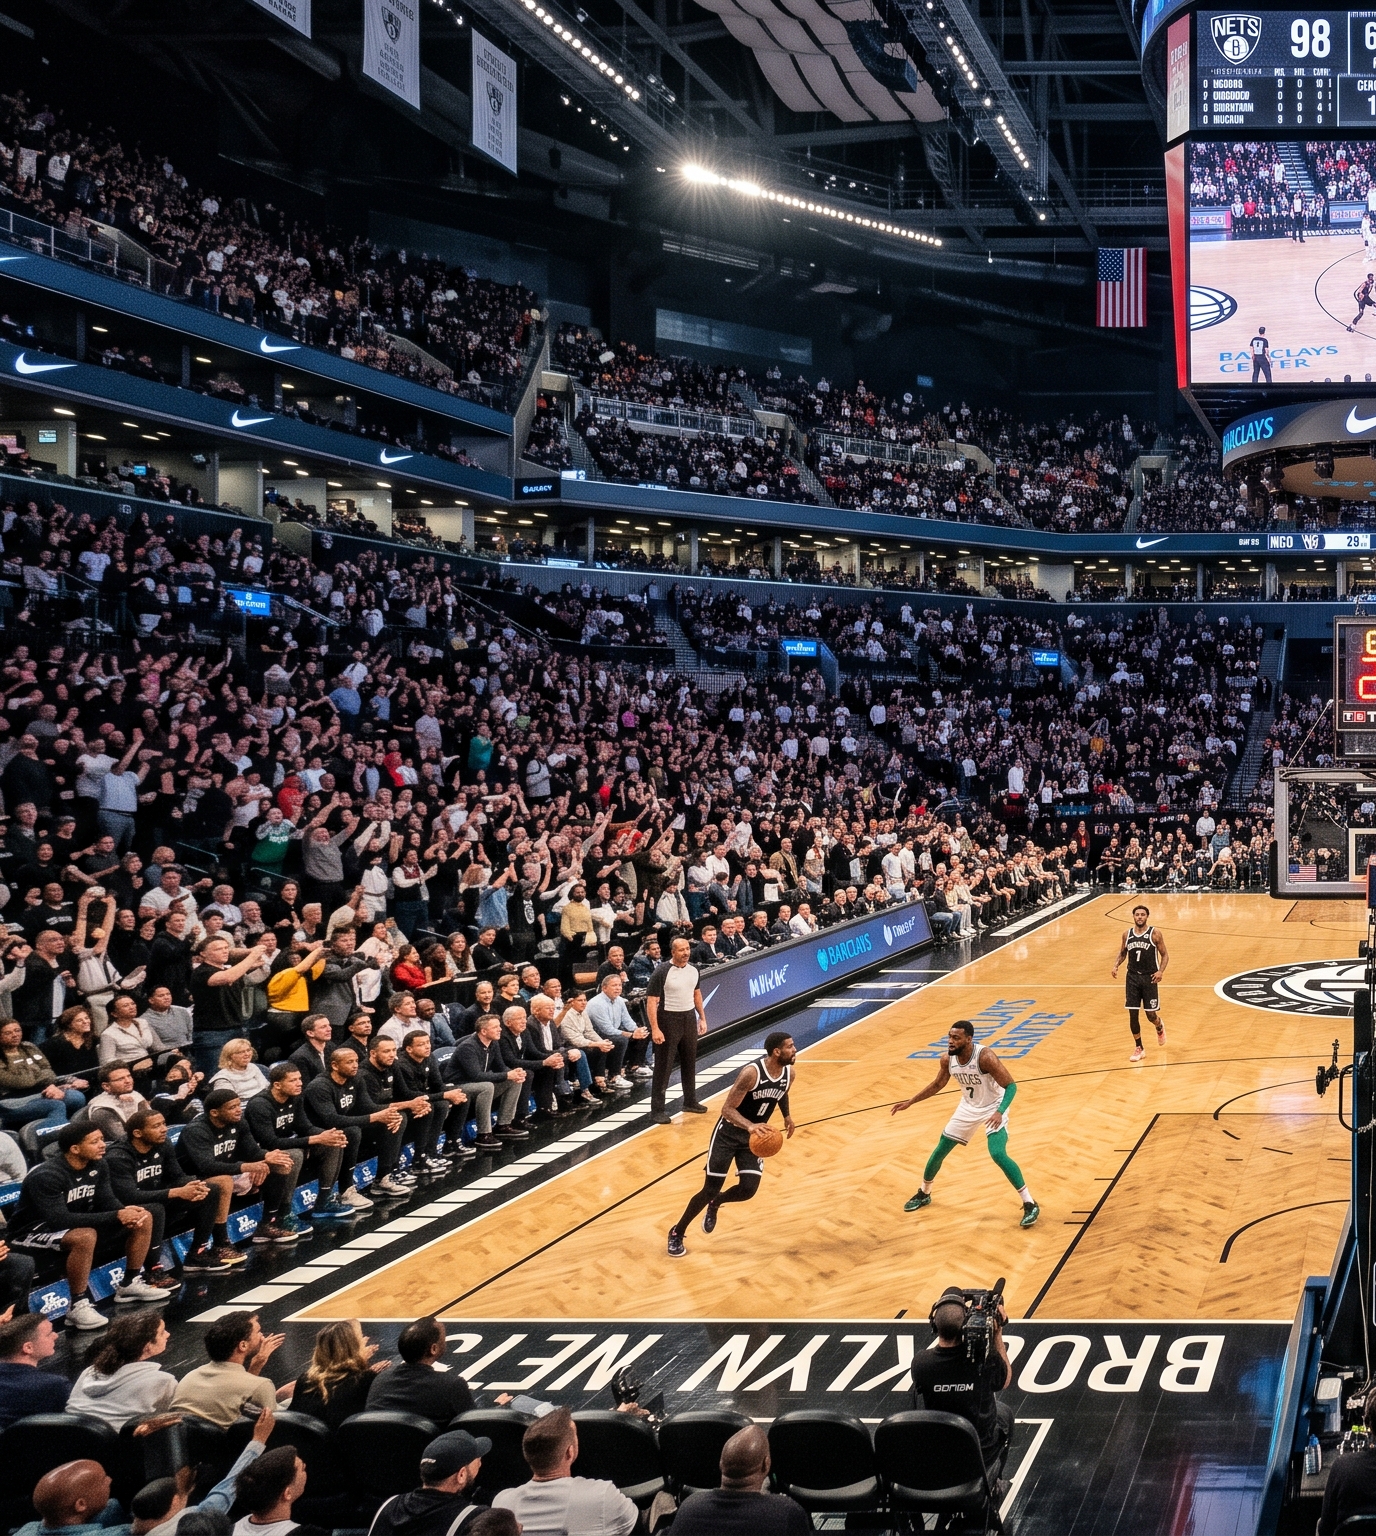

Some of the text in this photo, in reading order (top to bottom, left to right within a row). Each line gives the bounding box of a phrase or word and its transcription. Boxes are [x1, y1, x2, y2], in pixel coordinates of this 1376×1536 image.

[1214, 17, 1259, 37] NETS
[1290, 19, 1331, 58] 98
[1367, 95, 1376, 115] 1
[1219, 345, 1339, 362] BACLAYS
[1219, 358, 1311, 373] CETER
[1346, 535, 1360, 547] 29
[966, 1086, 975, 1099] 7
